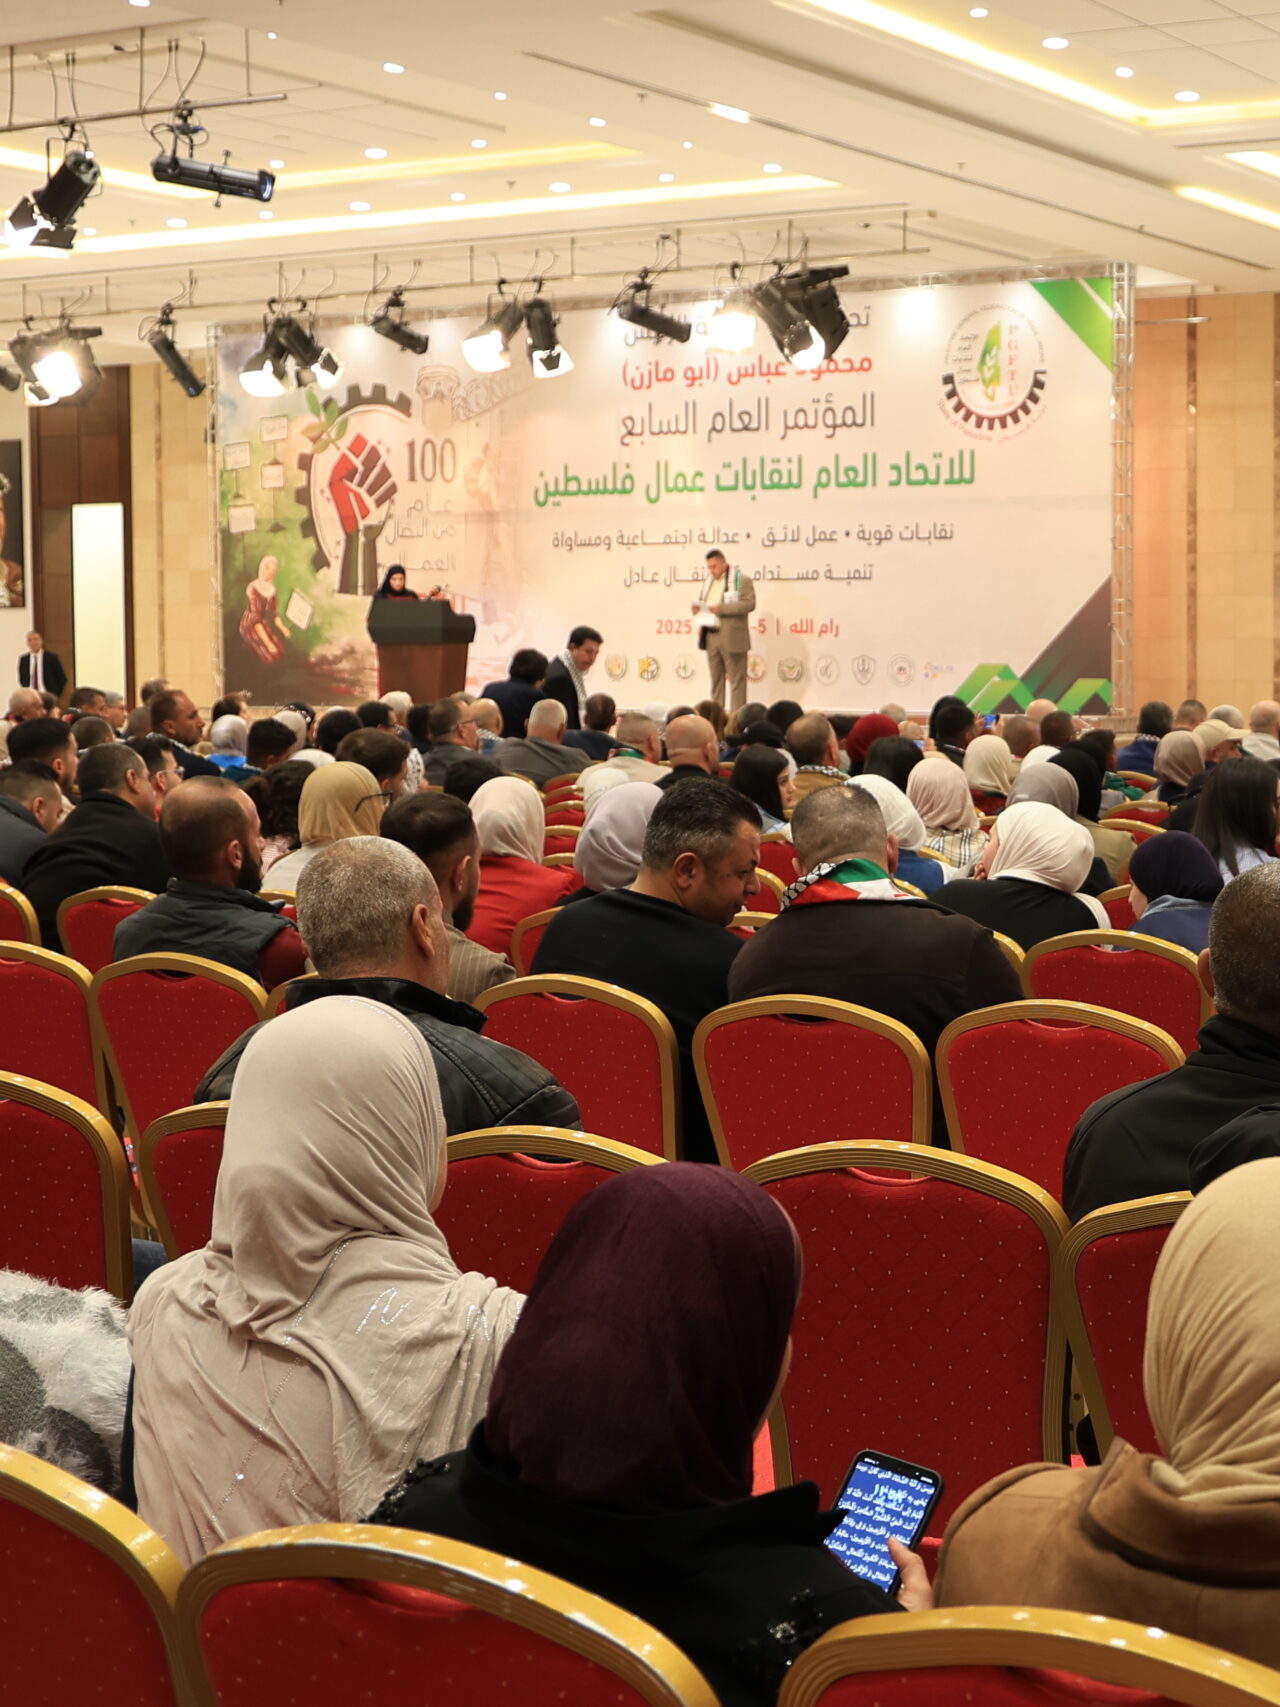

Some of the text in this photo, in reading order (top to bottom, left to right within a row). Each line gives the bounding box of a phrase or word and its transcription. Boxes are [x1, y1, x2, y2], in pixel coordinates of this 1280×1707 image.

[726, 354, 786, 385] عباس
[795, 354, 873, 383] محمو
[619, 392, 876, 447] المؤتمر العام السابع
[406, 438, 457, 484] 100
[533, 448, 976, 508] للاتحاد العام لنقابات عمال فلسطين
[551, 530, 612, 552] ومساواة
[615, 527, 693, 550] اجتماعية
[697, 526, 740, 545] عدالة
[805, 525, 838, 548] عمل
[856, 524, 893, 546] قوية
[899, 522, 954, 546] نقابات
[623, 566, 658, 588] عادل
[824, 564, 874, 586] تنمية
[655, 619, 692, 635] 2025
[788, 618, 814, 636] الله
[818, 620, 840, 638] رام
